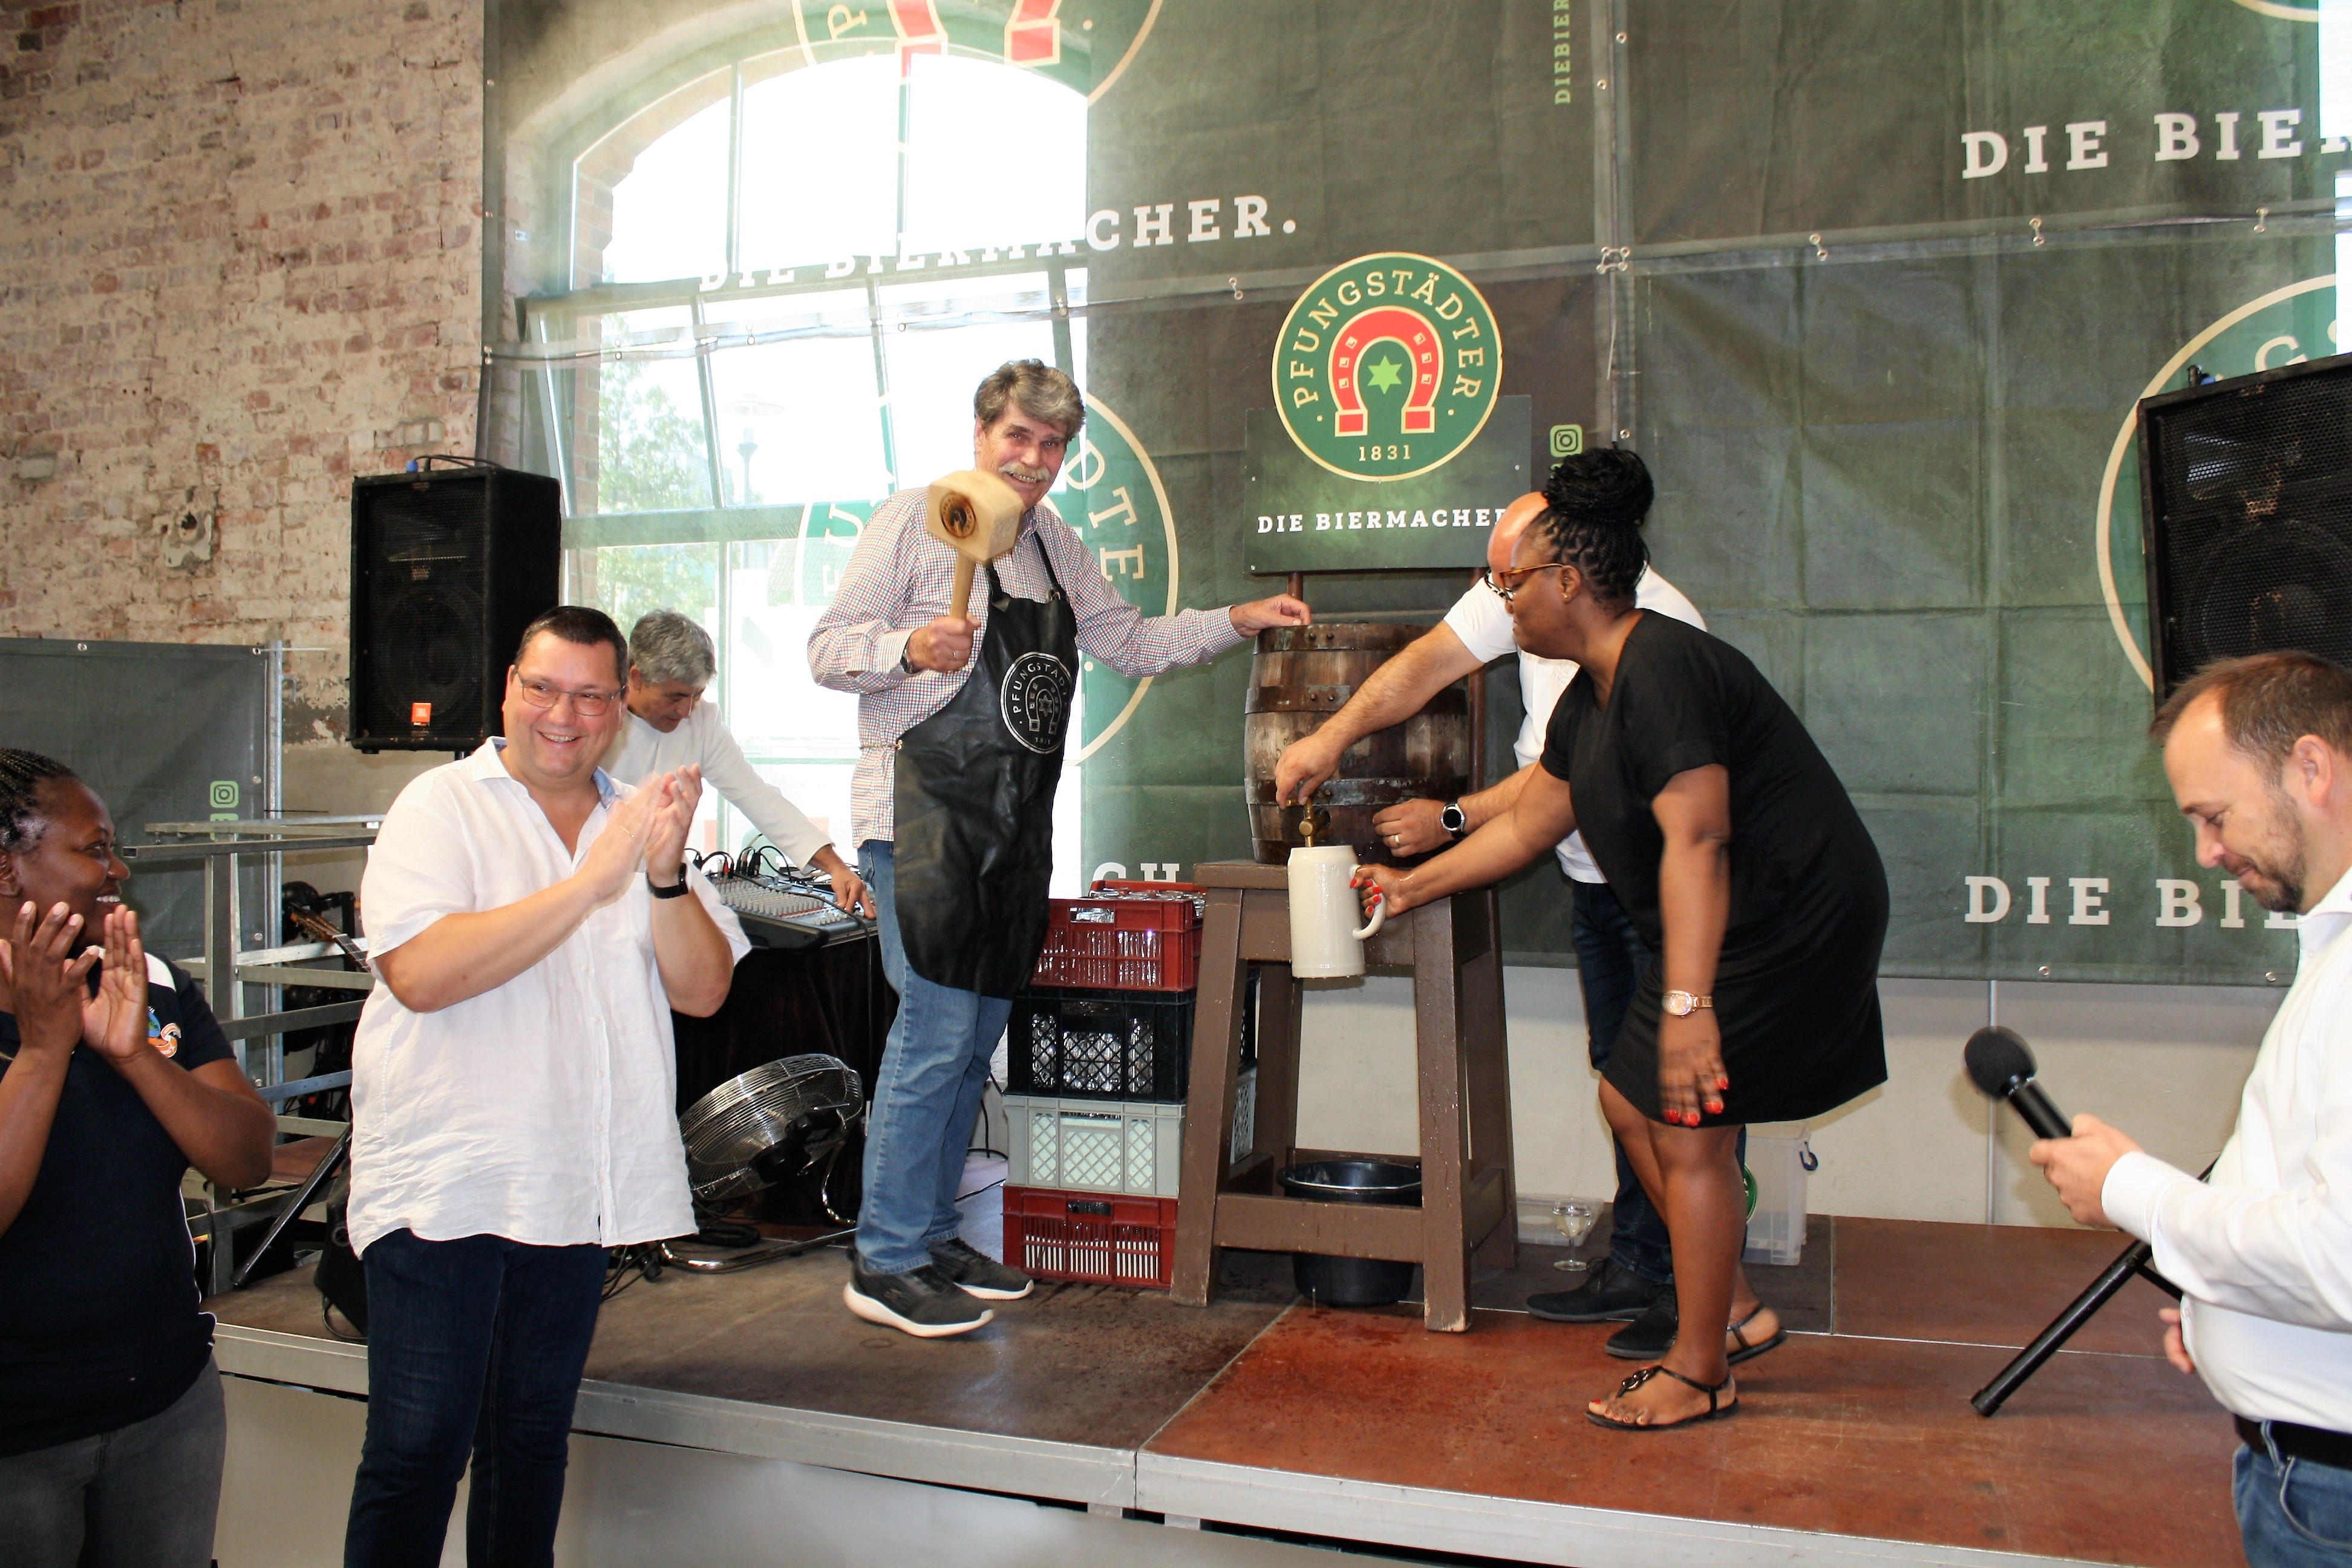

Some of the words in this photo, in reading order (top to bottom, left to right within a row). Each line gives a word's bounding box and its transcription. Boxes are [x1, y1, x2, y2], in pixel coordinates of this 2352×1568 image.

[1961, 120, 2108, 180] DIE
[1290, 270, 1485, 408] PFUNGSTÄDTER
[1359, 445, 1411, 462] 1831
[1258, 514, 1303, 534] DIE
[1964, 876, 2110, 926] DIE
